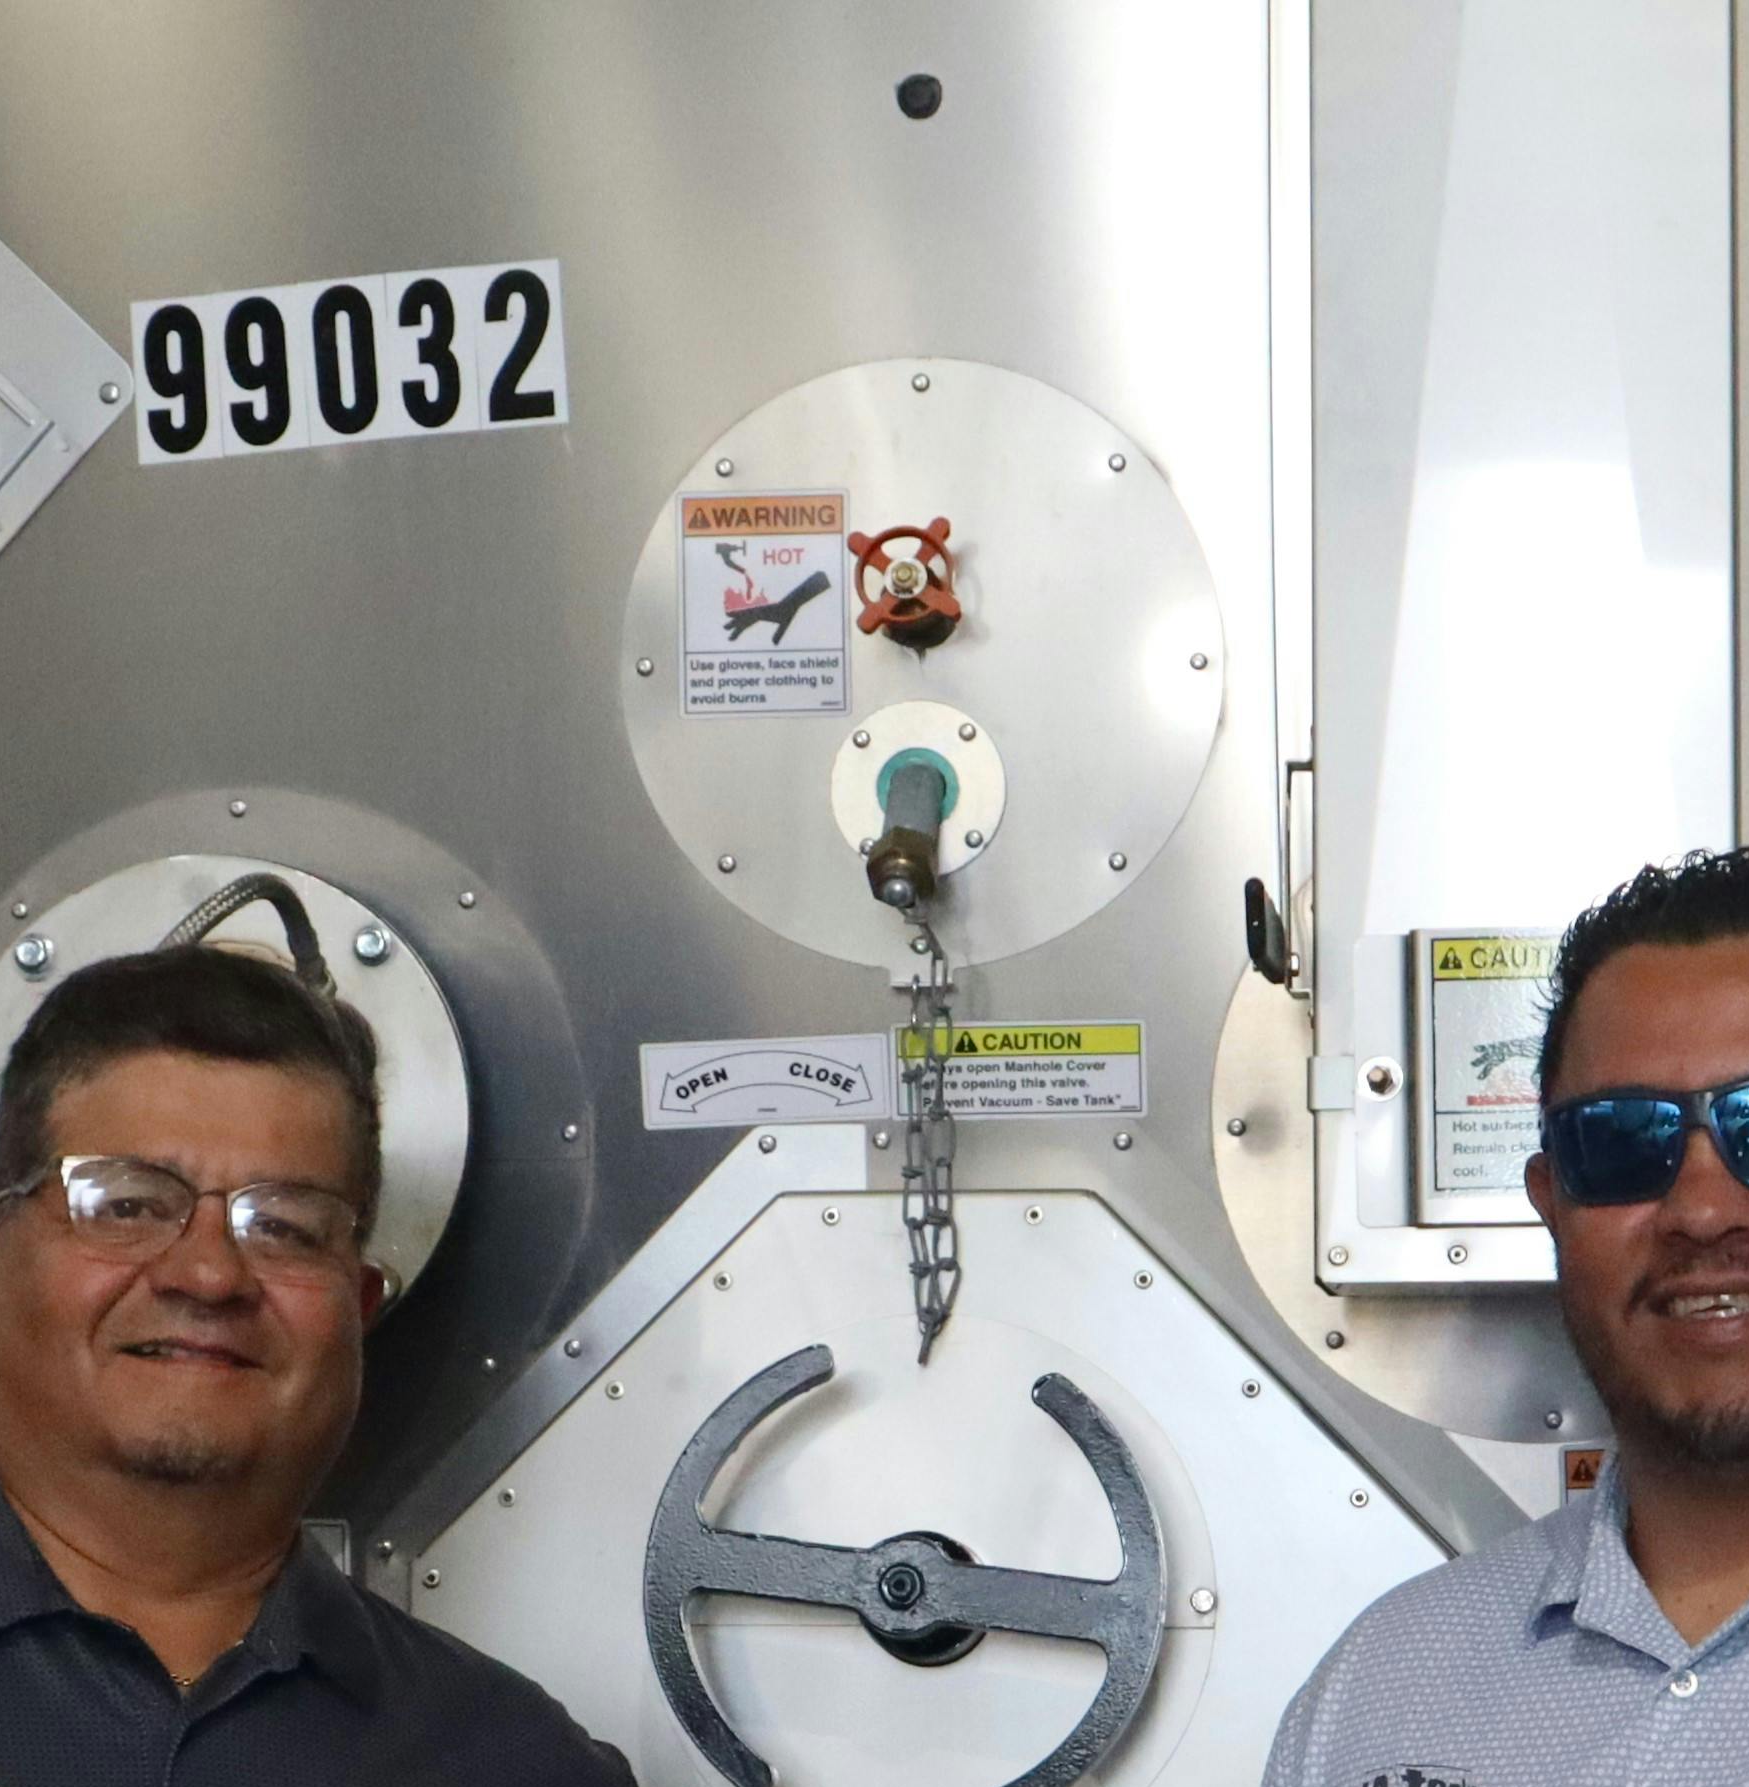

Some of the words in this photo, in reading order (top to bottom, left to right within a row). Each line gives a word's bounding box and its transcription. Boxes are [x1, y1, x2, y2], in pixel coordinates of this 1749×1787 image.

[143, 268, 556, 455] 99032
[712, 505, 836, 527] WARNING
[762, 548, 805, 566] HOT
[690, 660, 715, 671] Use
[719, 659, 765, 673] gloves,
[768, 658, 796, 670] face
[800, 657, 840, 669] shield
[690, 676, 714, 688] and
[718, 676, 761, 690] proper
[765, 673, 818, 688] clothing
[821, 674, 834, 686] to
[690, 692, 725, 704] avoid
[729, 691, 767, 703] burns
[982, 1032, 1082, 1051] CAUTION
[916, 1062, 963, 1076] Awys
[966, 1062, 1001, 1076] open
[1005, 1060, 1063, 1074] Manhole
[1066, 1059, 1107, 1072] Cover
[675, 1067, 729, 1100] OPEN
[789, 1061, 857, 1094] CLOSE
[916, 1077, 958, 1091] efre
[961, 1077, 1017, 1093] opening
[1020, 1076, 1047, 1089] this
[1050, 1076, 1091, 1090] valve.
[922, 1093, 975, 1109] Pvent
[979, 1093, 1033, 1108] Vacuum
[1046, 1093, 1079, 1107] Save
[1453, 1120, 1478, 1133] Hot
[1453, 1142, 1507, 1155] Remain
